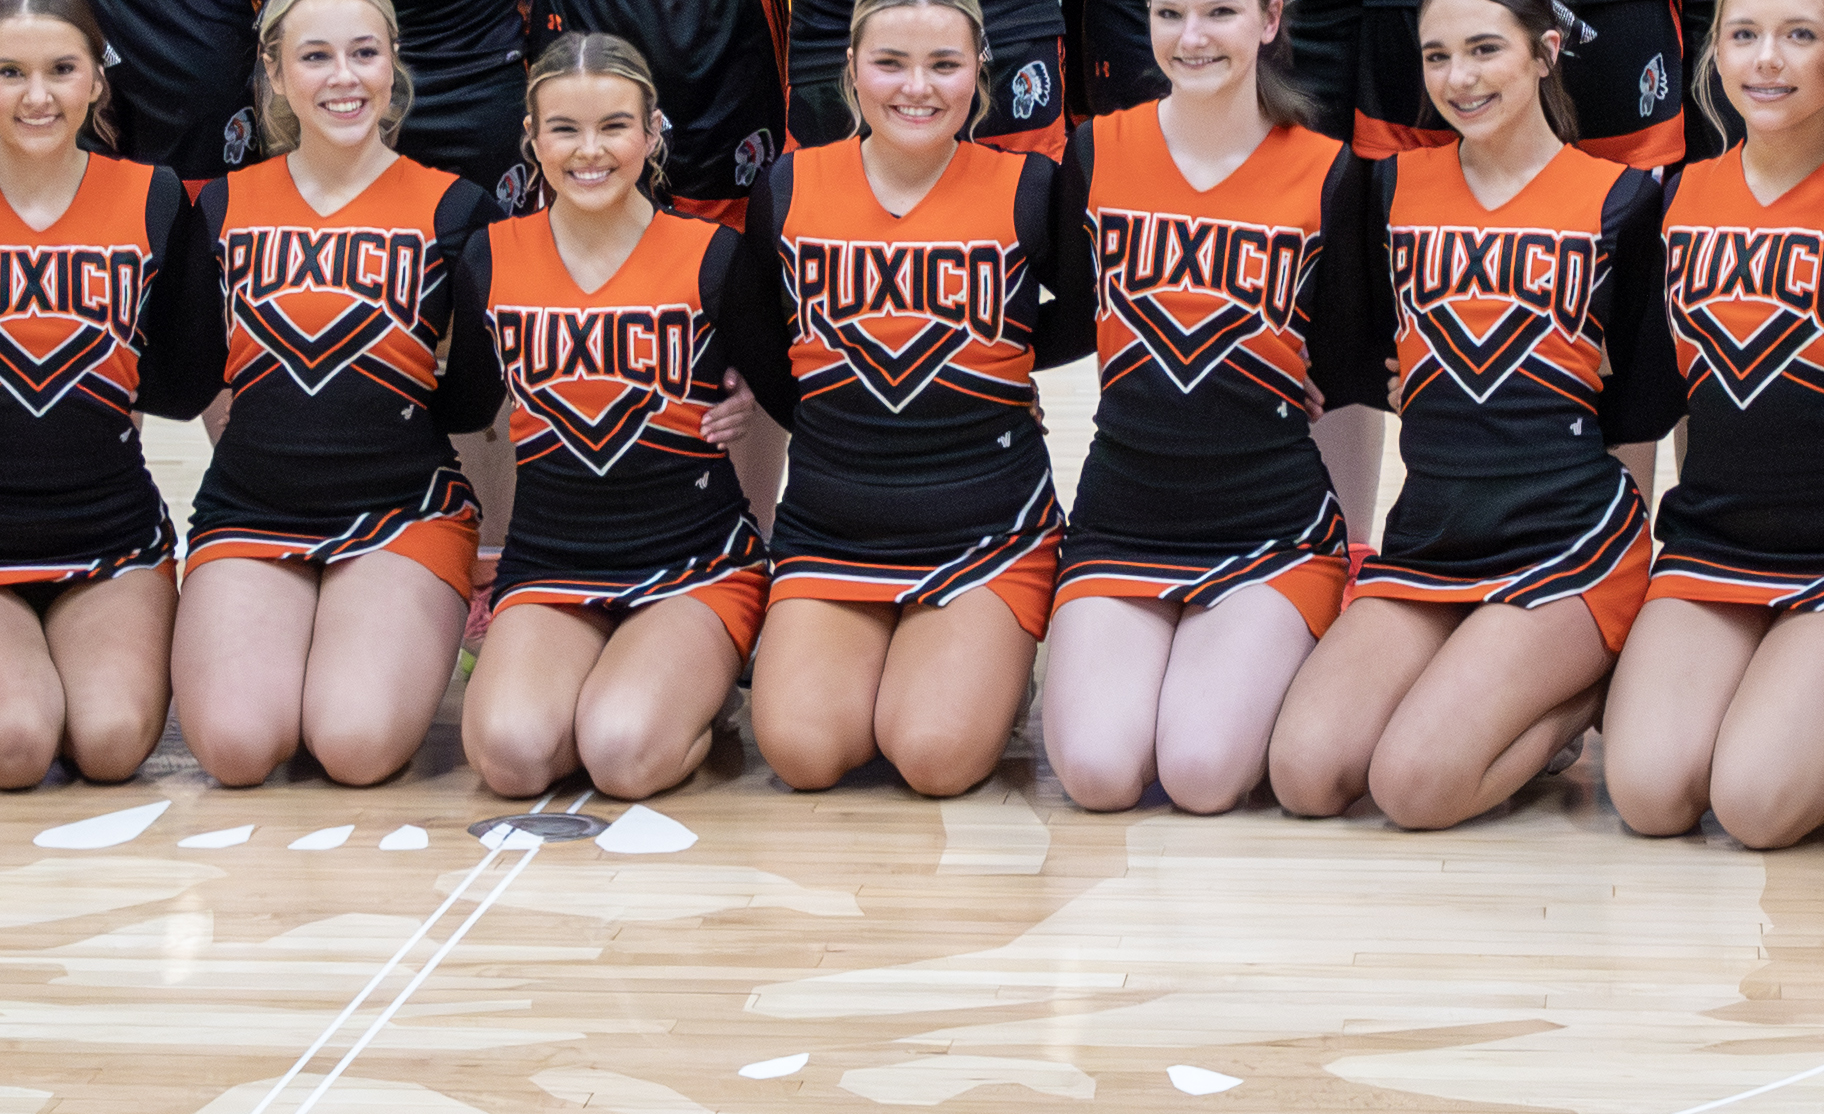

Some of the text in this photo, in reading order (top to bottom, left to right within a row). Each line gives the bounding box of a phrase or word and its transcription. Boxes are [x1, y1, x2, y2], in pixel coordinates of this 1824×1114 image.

[222, 226, 426, 338] PUXICO
[793, 237, 1007, 346] PUXICO
[1097, 207, 1307, 336] PUXICO
[1389, 225, 1600, 343] PUXICO
[493, 303, 694, 406] PUXICO
